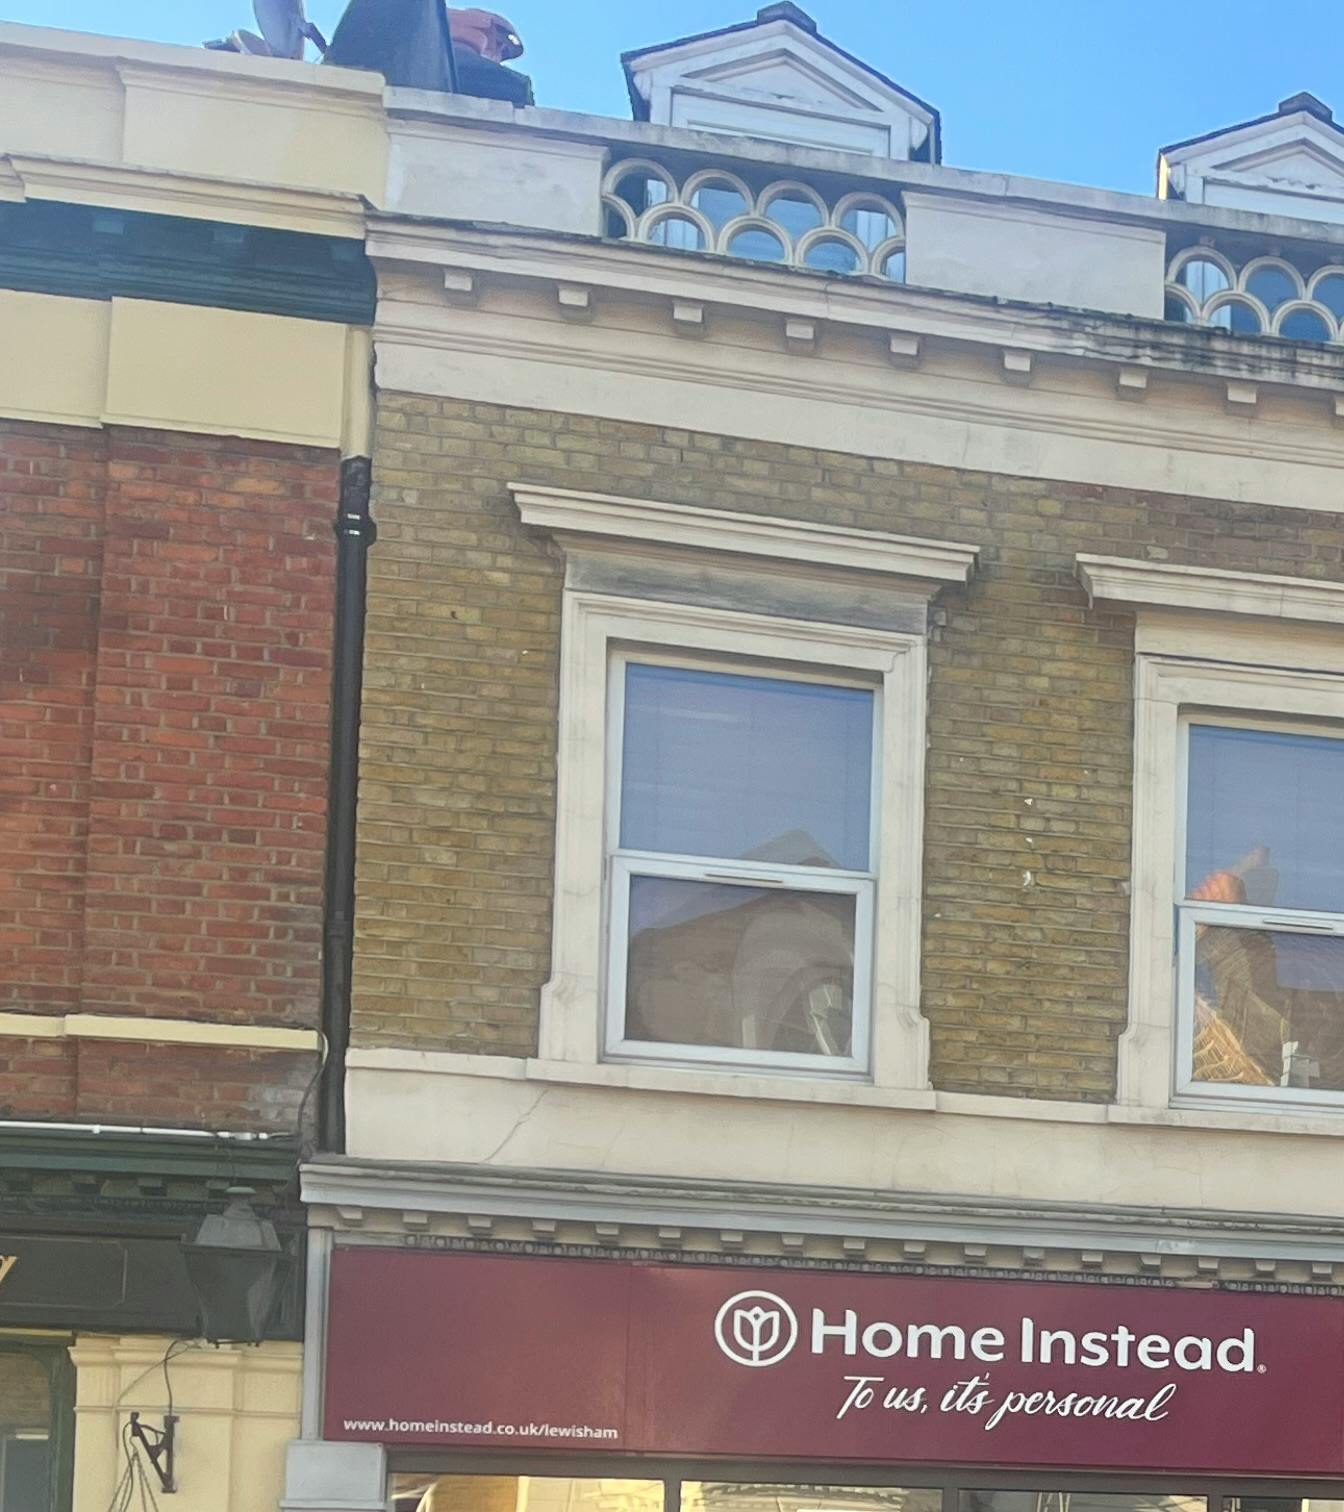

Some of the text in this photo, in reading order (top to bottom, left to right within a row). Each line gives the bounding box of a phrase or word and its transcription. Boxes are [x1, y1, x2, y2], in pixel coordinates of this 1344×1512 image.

[810, 1308, 1005, 1362] Home
[343, 1417, 619, 1440] www.homeinstead.co.uk/lewisham
[837, 1372, 1177, 1431] To us, it's personal
